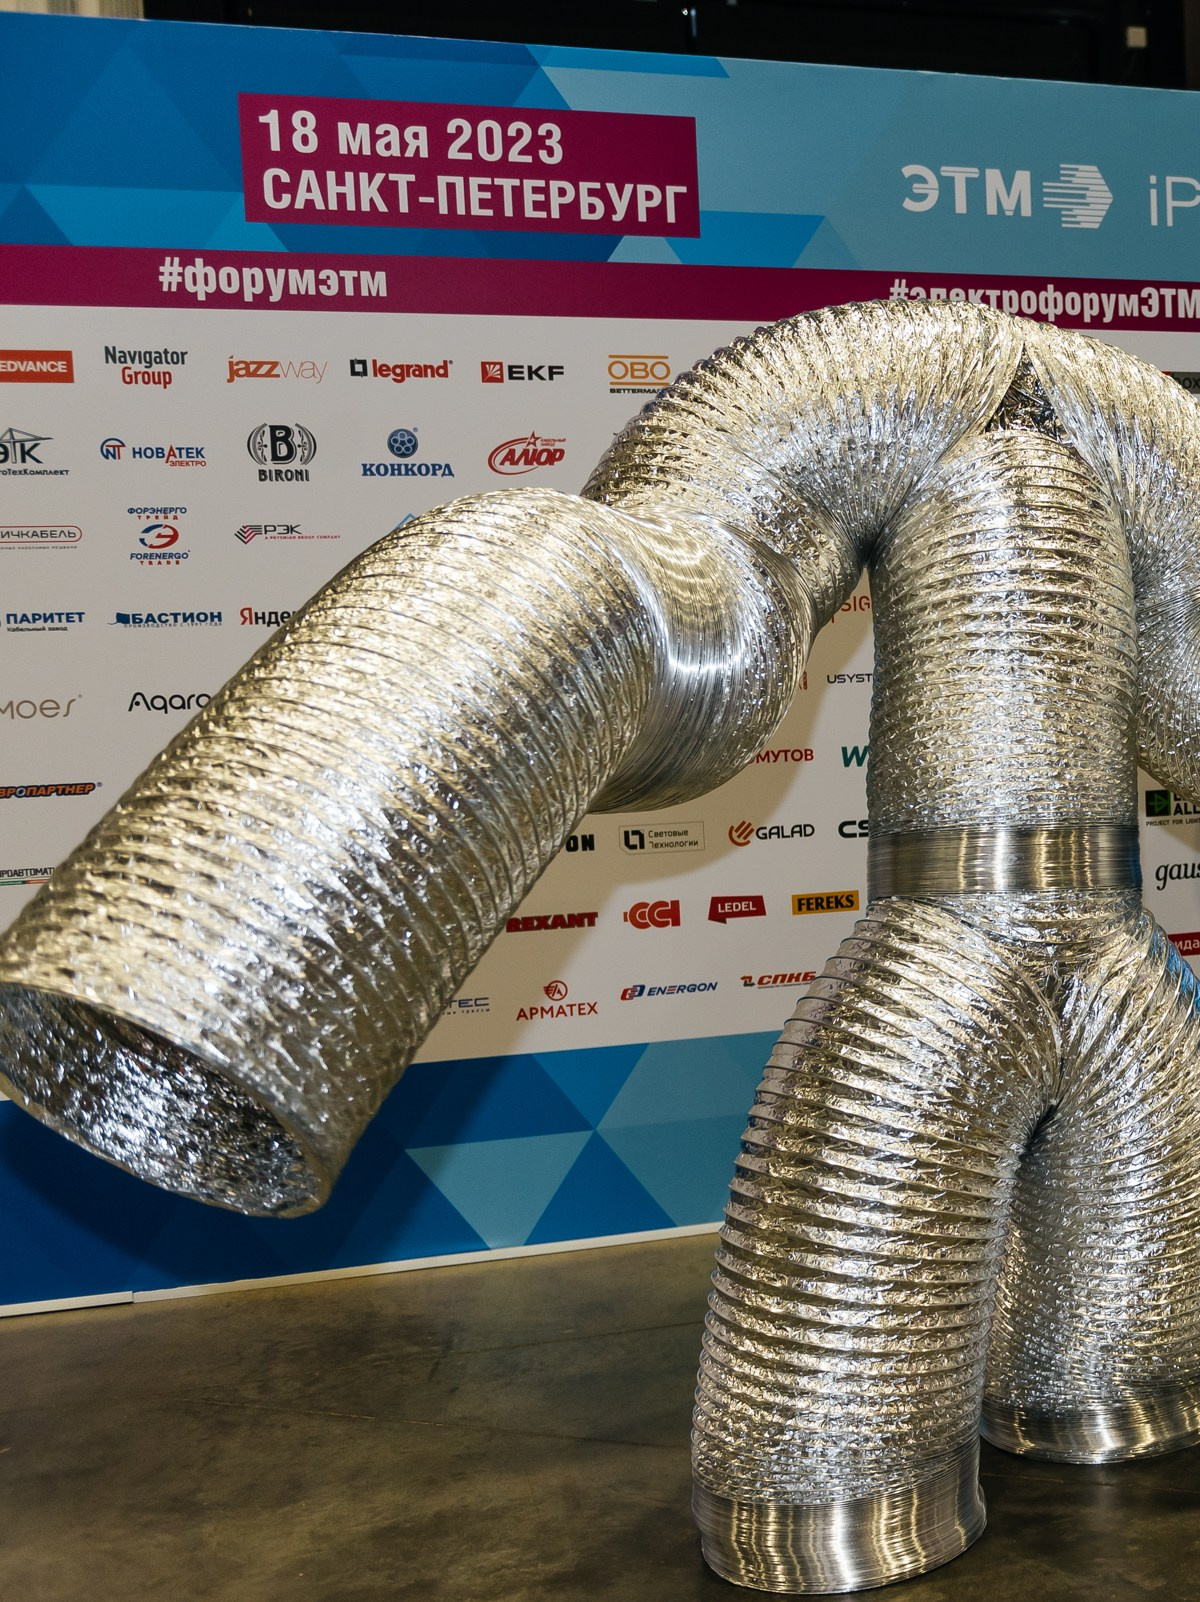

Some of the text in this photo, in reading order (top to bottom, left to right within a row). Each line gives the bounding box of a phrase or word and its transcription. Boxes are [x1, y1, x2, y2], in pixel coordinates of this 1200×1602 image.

[258, 109, 564, 165] 18 мая 2023
[262, 167, 688, 225] САНКТ-ПЕТЕРБУРГ
[900, 164, 1032, 218] ЭТМ
[158, 256, 388, 302] #форумэтм
[104, 346, 188, 369] Navigator
[122, 366, 173, 389] Group
[226, 355, 328, 384] jazzway
[372, 359, 449, 383] legrand
[508, 365, 565, 381] EKF
[607, 360, 671, 381] OBO
[132, 445, 205, 463] НОВАТЕК
[0, 469, 70, 477] оТехКомплект
[258, 469, 310, 482] BIRONI
[361, 463, 455, 478] КОНКОРД
[127, 506, 187, 515] ФОРЭНЕРГО
[264, 524, 303, 535] РЭК
[130, 551, 189, 560] FORENERGO
[6, 612, 86, 624] ПАРИТЕТ
[131, 612, 223, 624] БАСТИОН
[240, 607, 296, 627] Янде
[750, 749, 815, 764] МУТОВ
[648, 830, 689, 838] Световые
[756, 824, 815, 840] GALAD
[717, 900, 757, 914] LEDEL
[797, 894, 855, 913] FEREKS
[505, 912, 598, 932] REXANT
[757, 971, 816, 986] СПКБ
[647, 982, 718, 997] ENERGON
[516, 1002, 599, 1021] АРМАТЕХ
